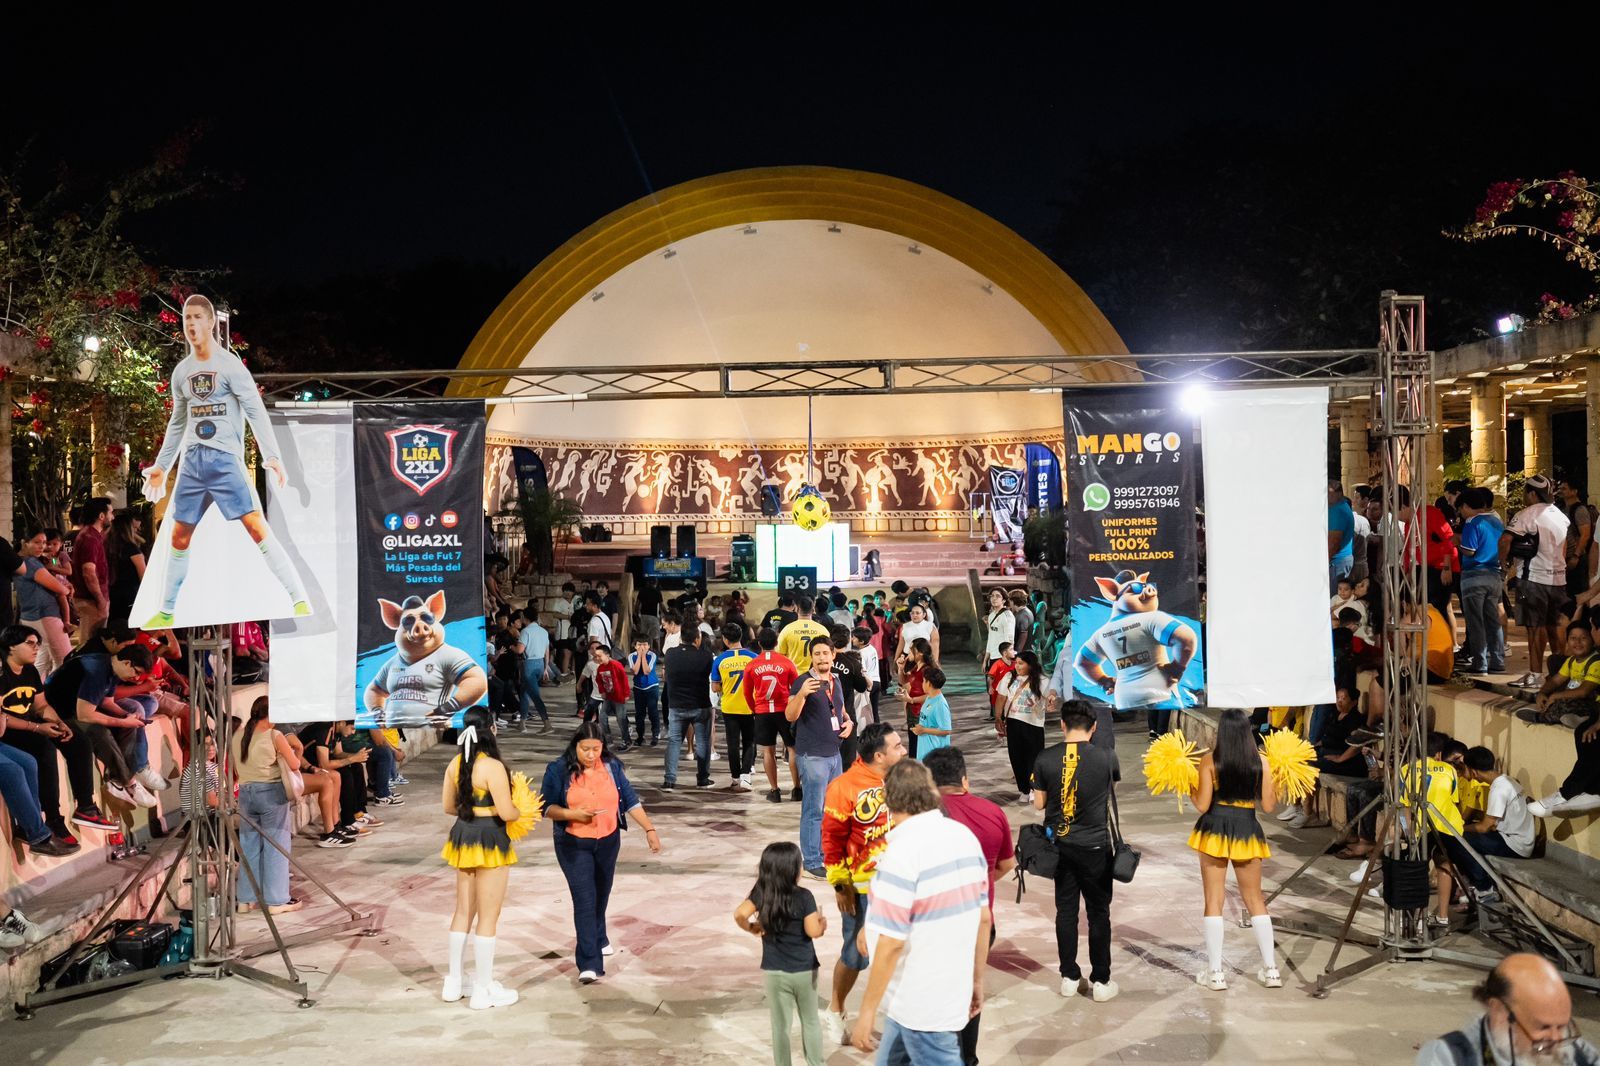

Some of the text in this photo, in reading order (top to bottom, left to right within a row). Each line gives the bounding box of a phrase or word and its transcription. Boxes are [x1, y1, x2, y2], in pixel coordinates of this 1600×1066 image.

[1077, 431, 1181, 454] MANGO
[402, 447, 441, 461] LIGA
[1079, 452, 1181, 465] SPORTS
[405, 460, 439, 474] 2XL
[1113, 485, 1179, 498] 9991273097
[1114, 498, 1180, 509] 9995761946
[1102, 517, 1158, 527] UNIFORMES
[1104, 527, 1158, 537] FULL PRINT
[382, 534, 463, 550] @LIGA2XL
[1109, 537, 1150, 551] 100%
[385, 551, 462, 563] La Liga de Fut 7
[1088, 551, 1175, 562] PERSONALIZADOS
[386, 562, 461, 572] Más Pesada del
[405, 574, 444, 584] Sureste
[785, 575, 809, 590] B-3
[800, 635, 812, 657] 7
[1117, 635, 1128, 654] 7
[721, 660, 749, 670] RONALD
[754, 664, 784, 675] RONALDO
[729, 670, 745, 694] 7
[761, 675, 777, 700] 7
